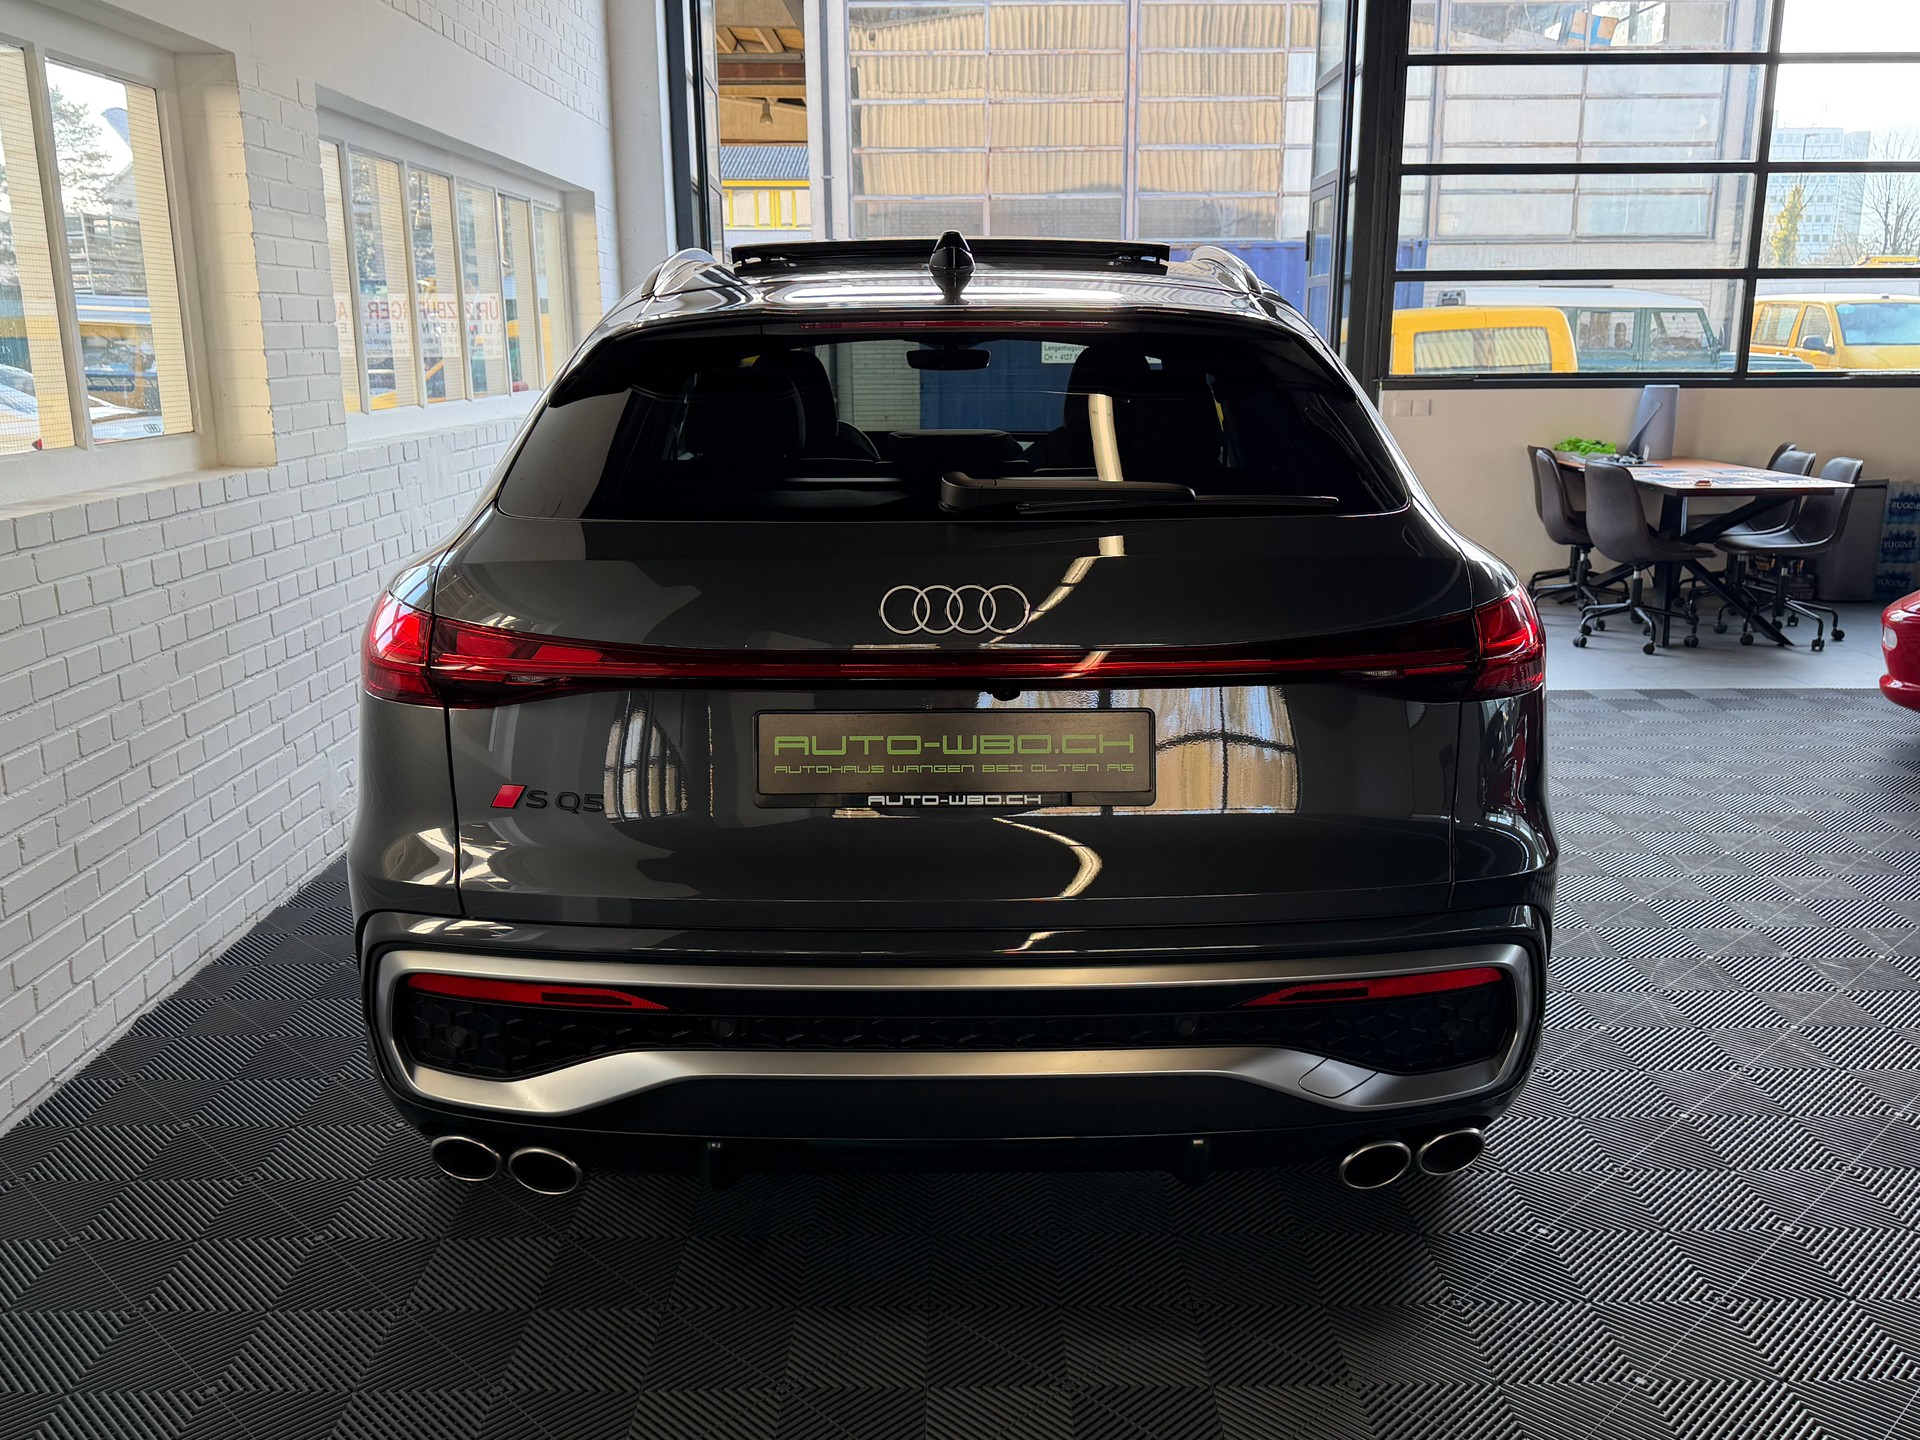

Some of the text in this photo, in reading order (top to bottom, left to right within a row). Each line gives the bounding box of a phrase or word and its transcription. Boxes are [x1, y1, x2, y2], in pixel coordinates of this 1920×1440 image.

[1044, 353, 1053, 361] CH
[774, 734, 1134, 756] AUTO-WBO.CH
[774, 763, 1134, 774] AUTOHAUS WANGEN BEI OLTEN AG
[555, 791, 604, 815] Q5
[867, 794, 1042, 806] AUTO-WBO.CH
